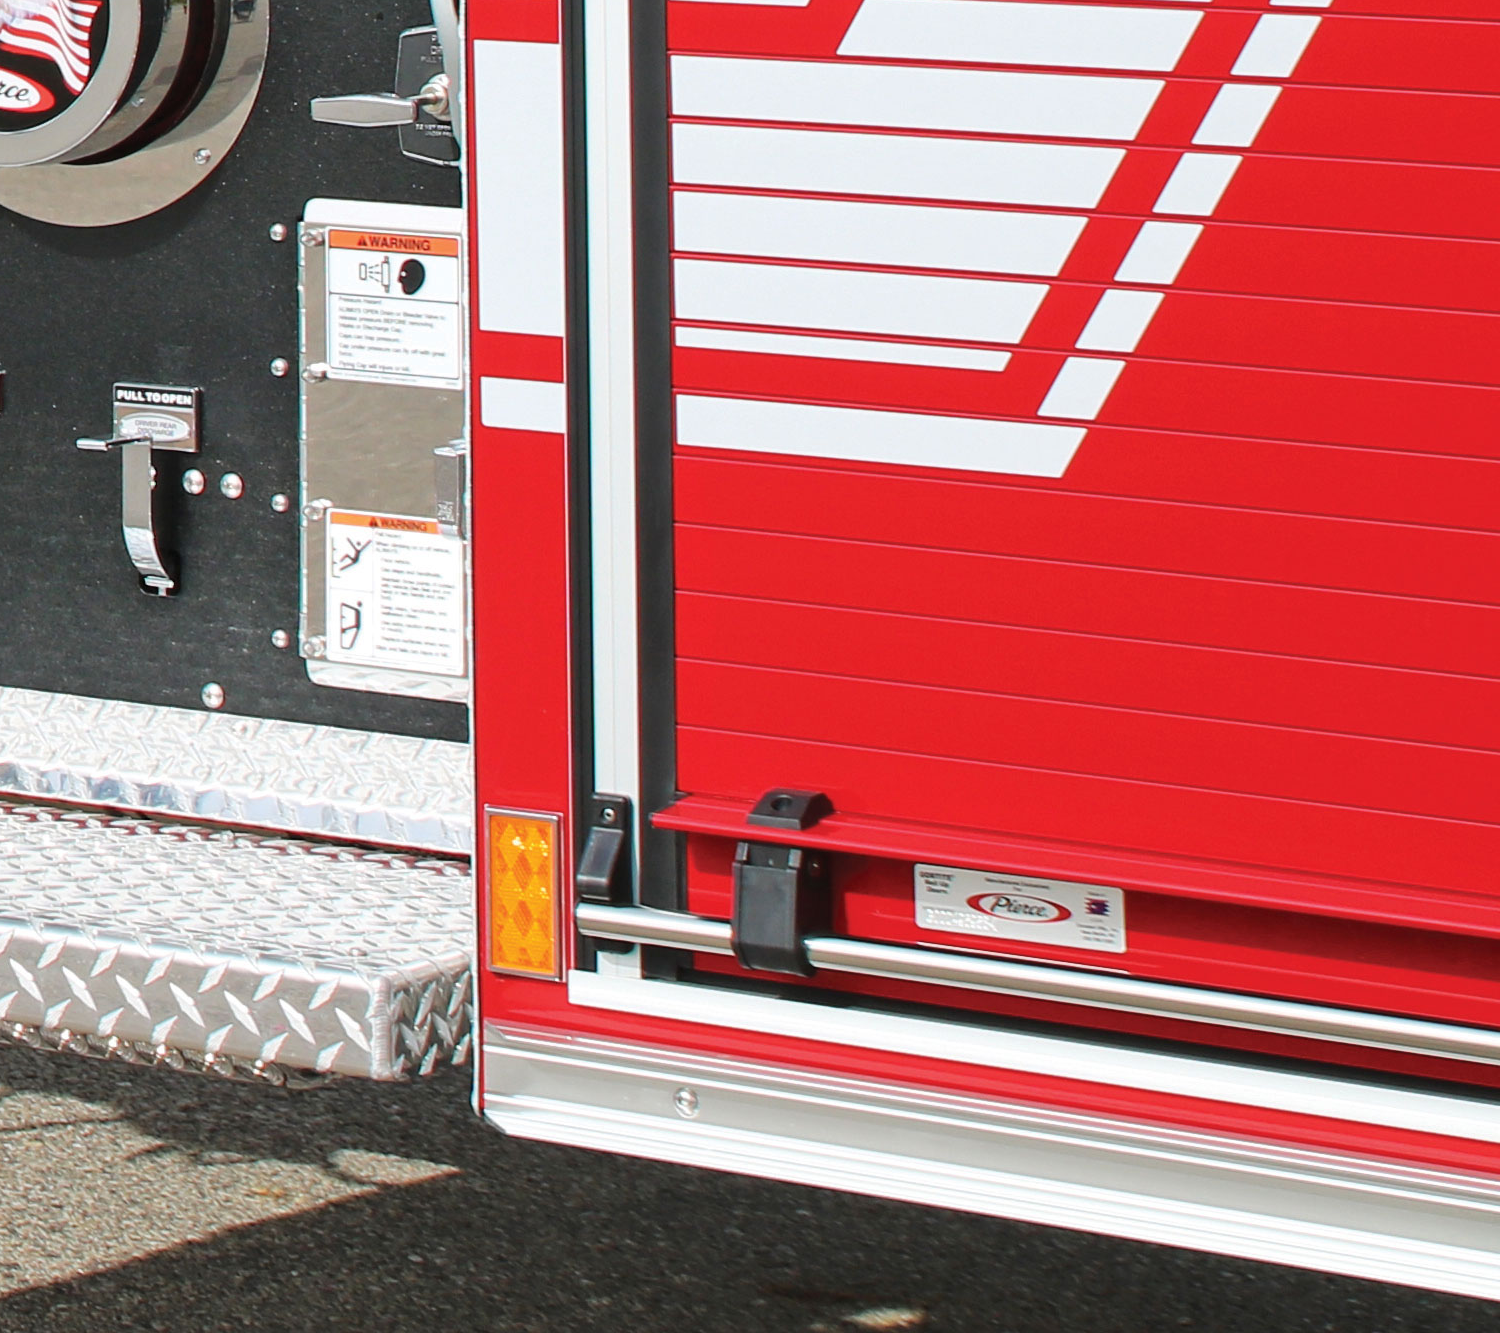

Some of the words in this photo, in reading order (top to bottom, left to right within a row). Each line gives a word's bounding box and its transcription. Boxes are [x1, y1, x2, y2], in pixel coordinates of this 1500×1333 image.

[369, 236, 431, 251] WARNING
[117, 390, 145, 402] PULL
[145, 392, 161, 403] TO
[161, 393, 192, 405] OPEN
[134, 419, 159, 427] DRIVER
[159, 420, 177, 428] REAR
[137, 427, 174, 437] DISCHARGE
[379, 517, 427, 532] WARNING
[990, 895, 1047, 916] Pierce
